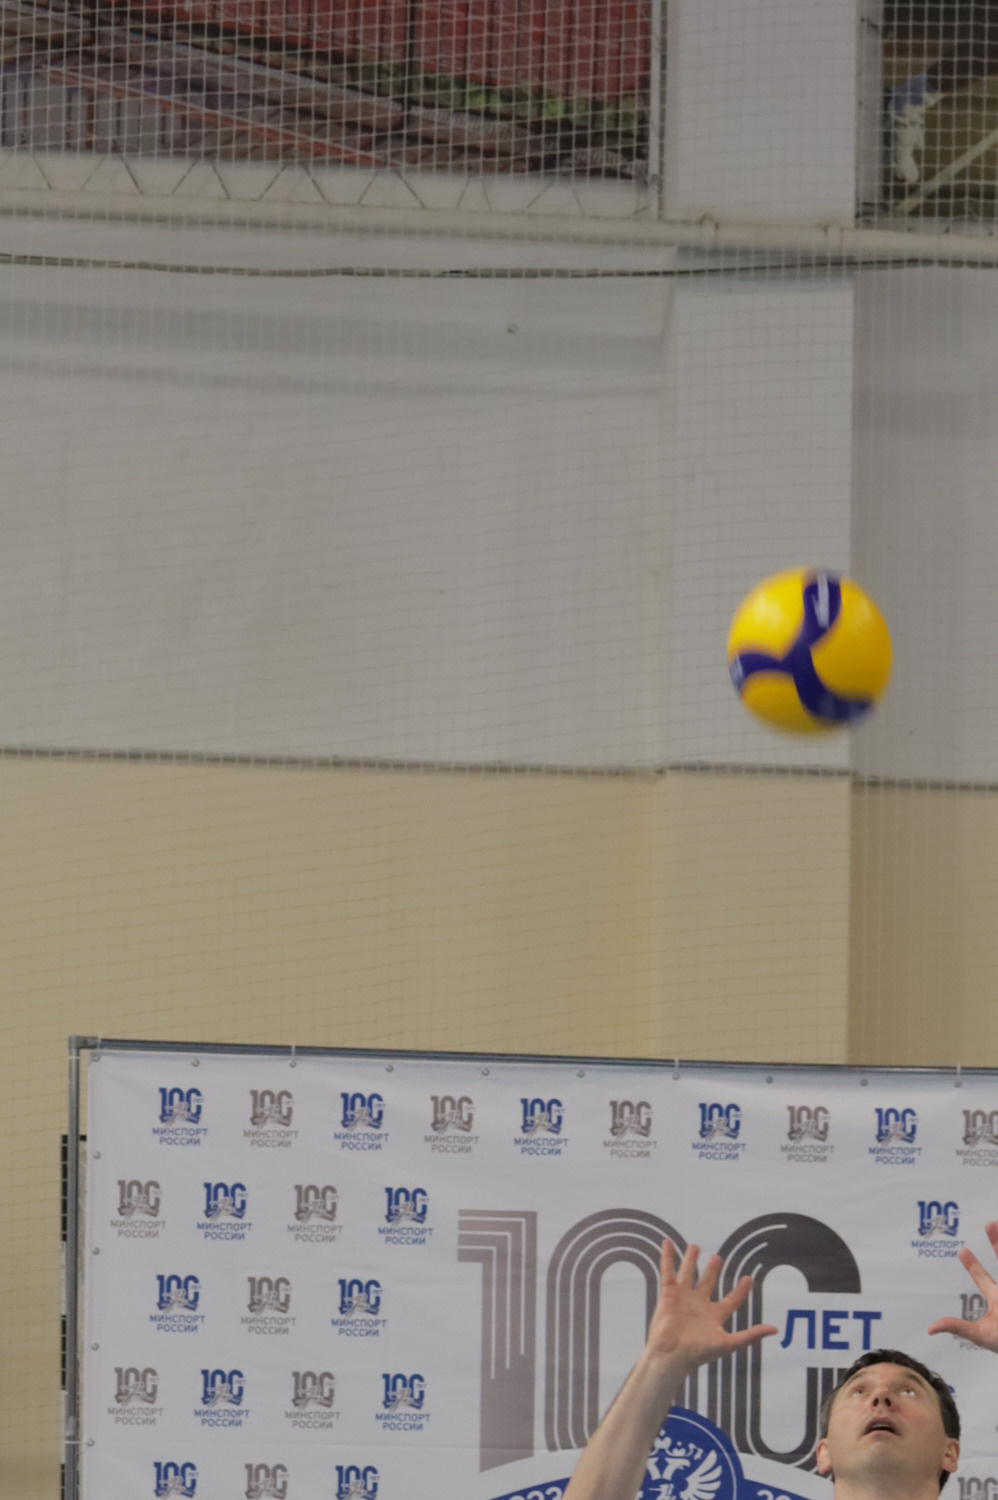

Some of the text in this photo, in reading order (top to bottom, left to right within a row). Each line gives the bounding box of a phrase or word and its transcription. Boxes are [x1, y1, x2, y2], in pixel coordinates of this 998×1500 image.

[152, 1127, 208, 1137] МИНСПОРТ
[243, 1129, 299, 1139] МИНСПОРТ
[159, 1137, 201, 1146] РОССИИ
[334, 1132, 389, 1142] МИНСПОРТ
[424, 1135, 479, 1144] МИНСПОРТ
[250, 1139, 292, 1149] РОССИИ
[341, 1142, 382, 1151] РОССИИ
[514, 1138, 568, 1147] МИНСПОРТ
[603, 1140, 657, 1149] МИНСПОРТ
[692, 1142, 746, 1152] МИНСПОРТ
[431, 1145, 472, 1154] РОССИИ
[521, 1147, 561, 1156] РОССИИ
[610, 1149, 650, 1159] РОССИИ
[869, 1147, 922, 1156] МИНСПОРТ
[699, 1152, 739, 1161] РОССИИ
[876, 1156, 915, 1166] РОССИИ
[110, 1220, 166, 1229] МИНСПОРТ
[197, 1222, 253, 1232] МИНСПОРТ
[287, 1224, 343, 1234] МИНСПОРТ
[118, 1229, 159, 1239] РОССИИ
[378, 1227, 433, 1236] МИНСПОРТ
[204, 1232, 246, 1241] РОССИИ
[295, 1234, 336, 1244] РОССИИ
[385, 1236, 426, 1246] РОССИИ
[911, 1240, 965, 1249] МИНСПОРТ
[918, 1249, 958, 1259] РОССИИ
[150, 1314, 206, 1324] МИНСПОРТ
[241, 1316, 297, 1326] МИНСПОРТ
[331, 1319, 387, 1328] МИНСПОРТ
[157, 1324, 198, 1333] РОССИИ
[248, 1326, 290, 1336] РОССИИ
[339, 1328, 380, 1337] РОССИИ
[780, 1309, 882, 1350] ЛЕТ
[108, 1407, 164, 1416] МИНСПОРТ
[194, 1409, 250, 1418] МИНСПОРТ
[285, 1411, 341, 1420] МИНСПОРТ
[115, 1417, 157, 1426] РОССИИ
[375, 1413, 431, 1422] МИНСПОРТ
[201, 1419, 243, 1428] РОССИИ
[292, 1421, 334, 1430] РОССИИ
[383, 1422, 424, 1432] РОССИИ
